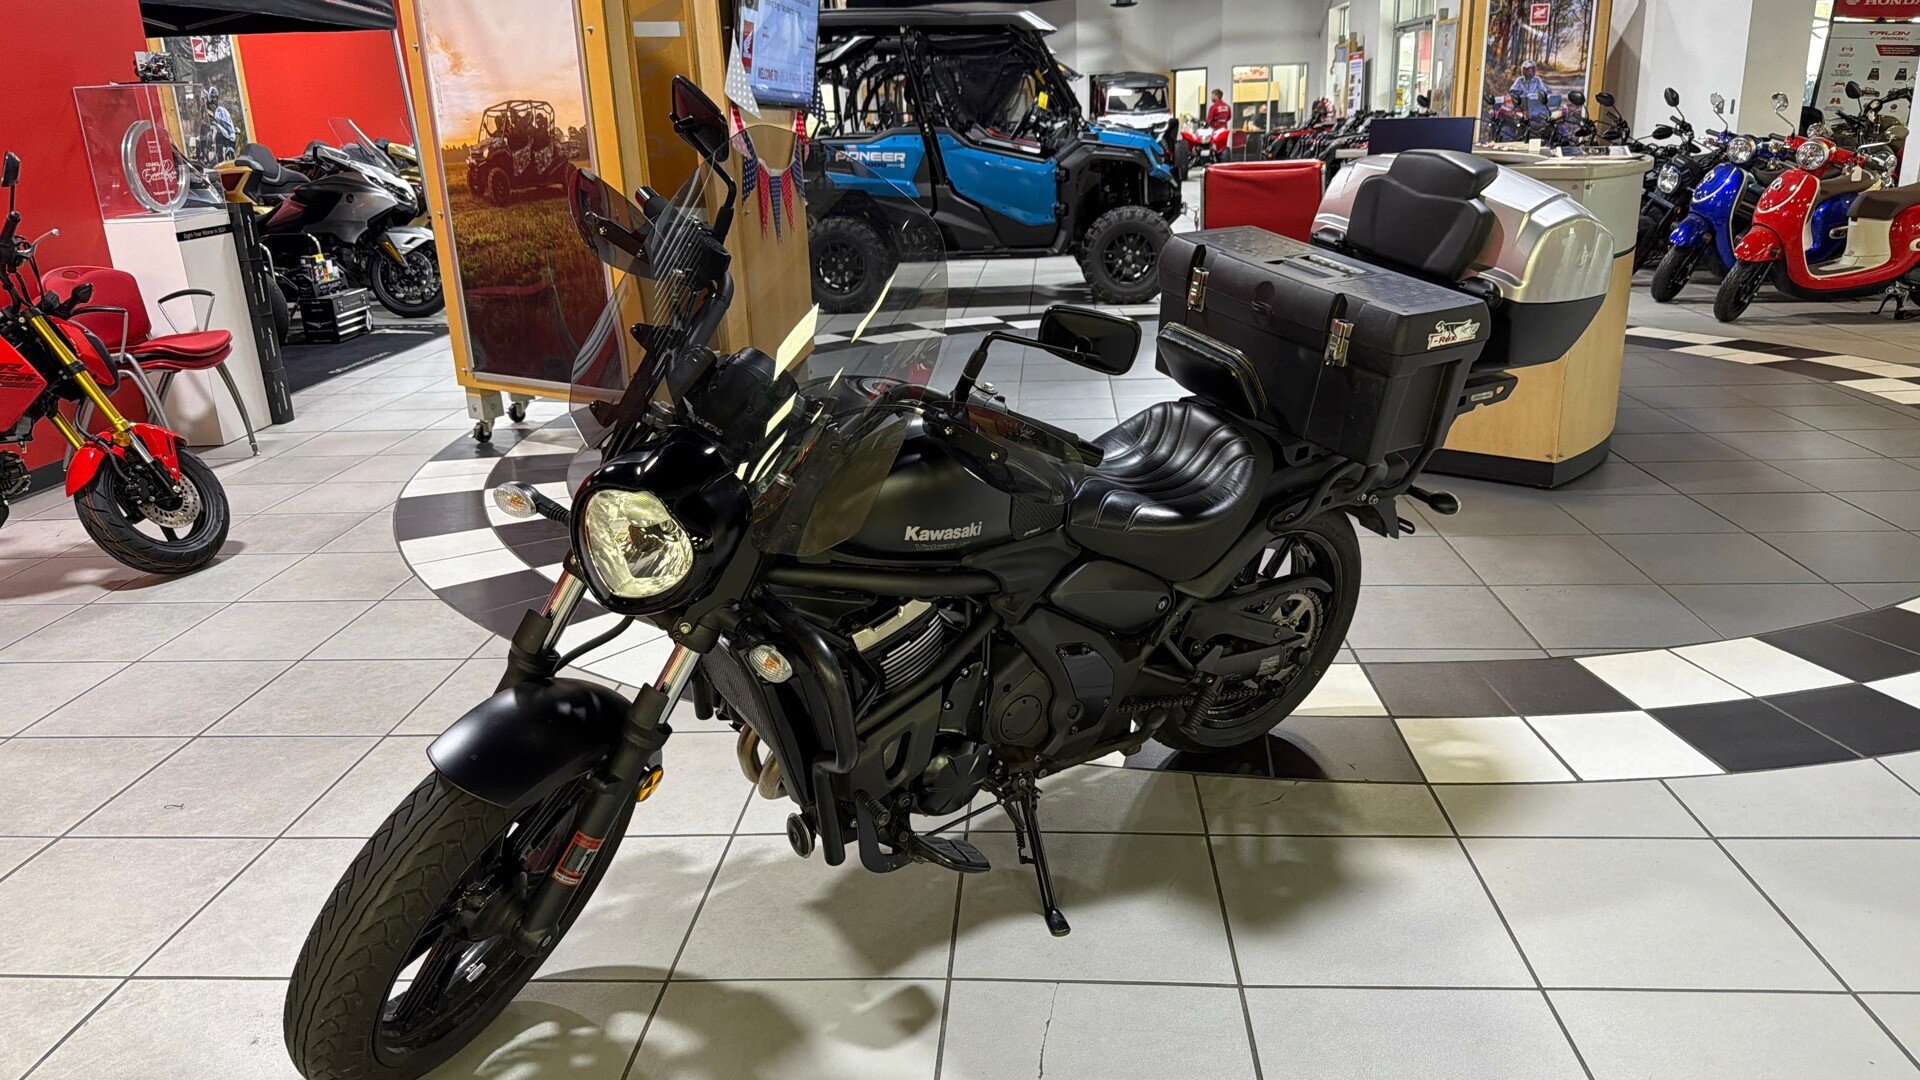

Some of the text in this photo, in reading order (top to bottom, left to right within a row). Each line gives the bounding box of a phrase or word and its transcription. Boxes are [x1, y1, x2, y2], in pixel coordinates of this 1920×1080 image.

[835, 150, 906, 162] PIONEER
[904, 521, 982, 541] Kawasaki
[915, 542, 957, 550] Vulcan
